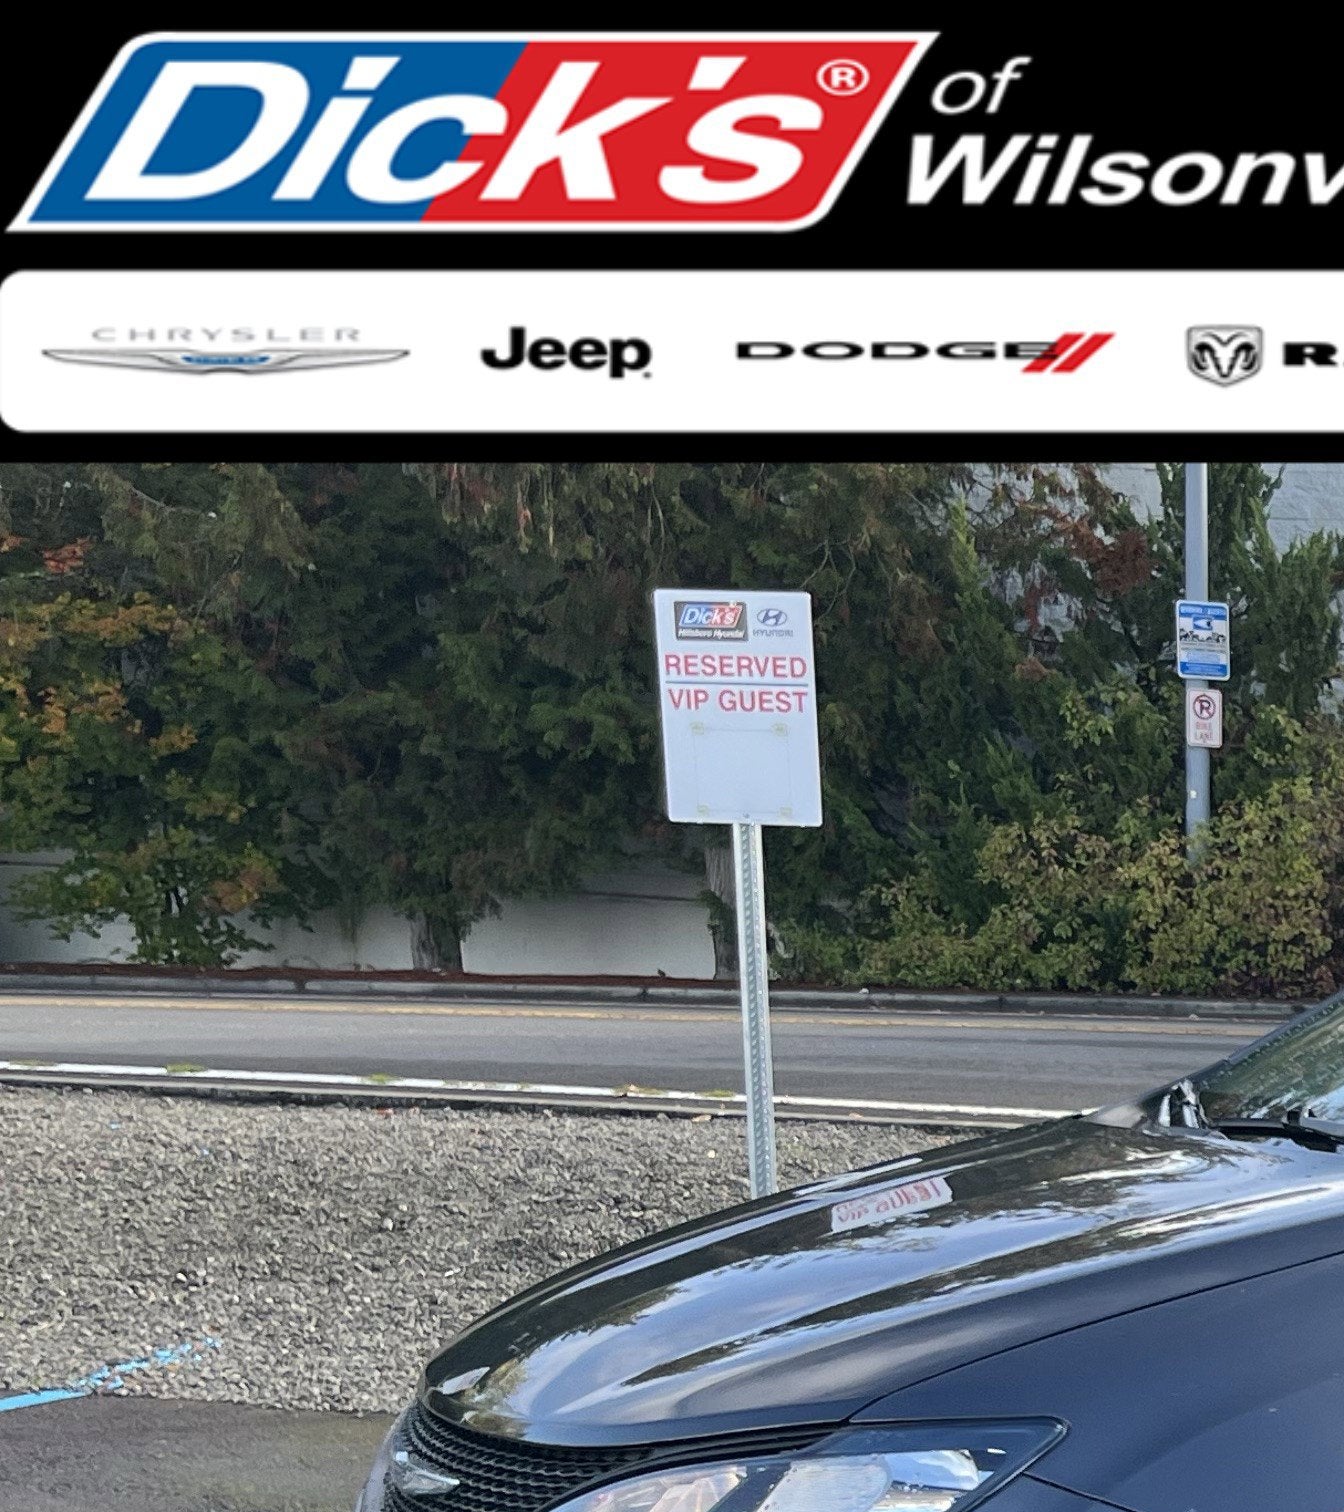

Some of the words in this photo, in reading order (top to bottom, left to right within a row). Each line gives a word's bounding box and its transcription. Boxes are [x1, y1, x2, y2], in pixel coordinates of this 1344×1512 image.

[664, 654, 808, 679] RESERVED
[668, 689, 710, 711] VIP
[718, 689, 809, 713] GUEST
